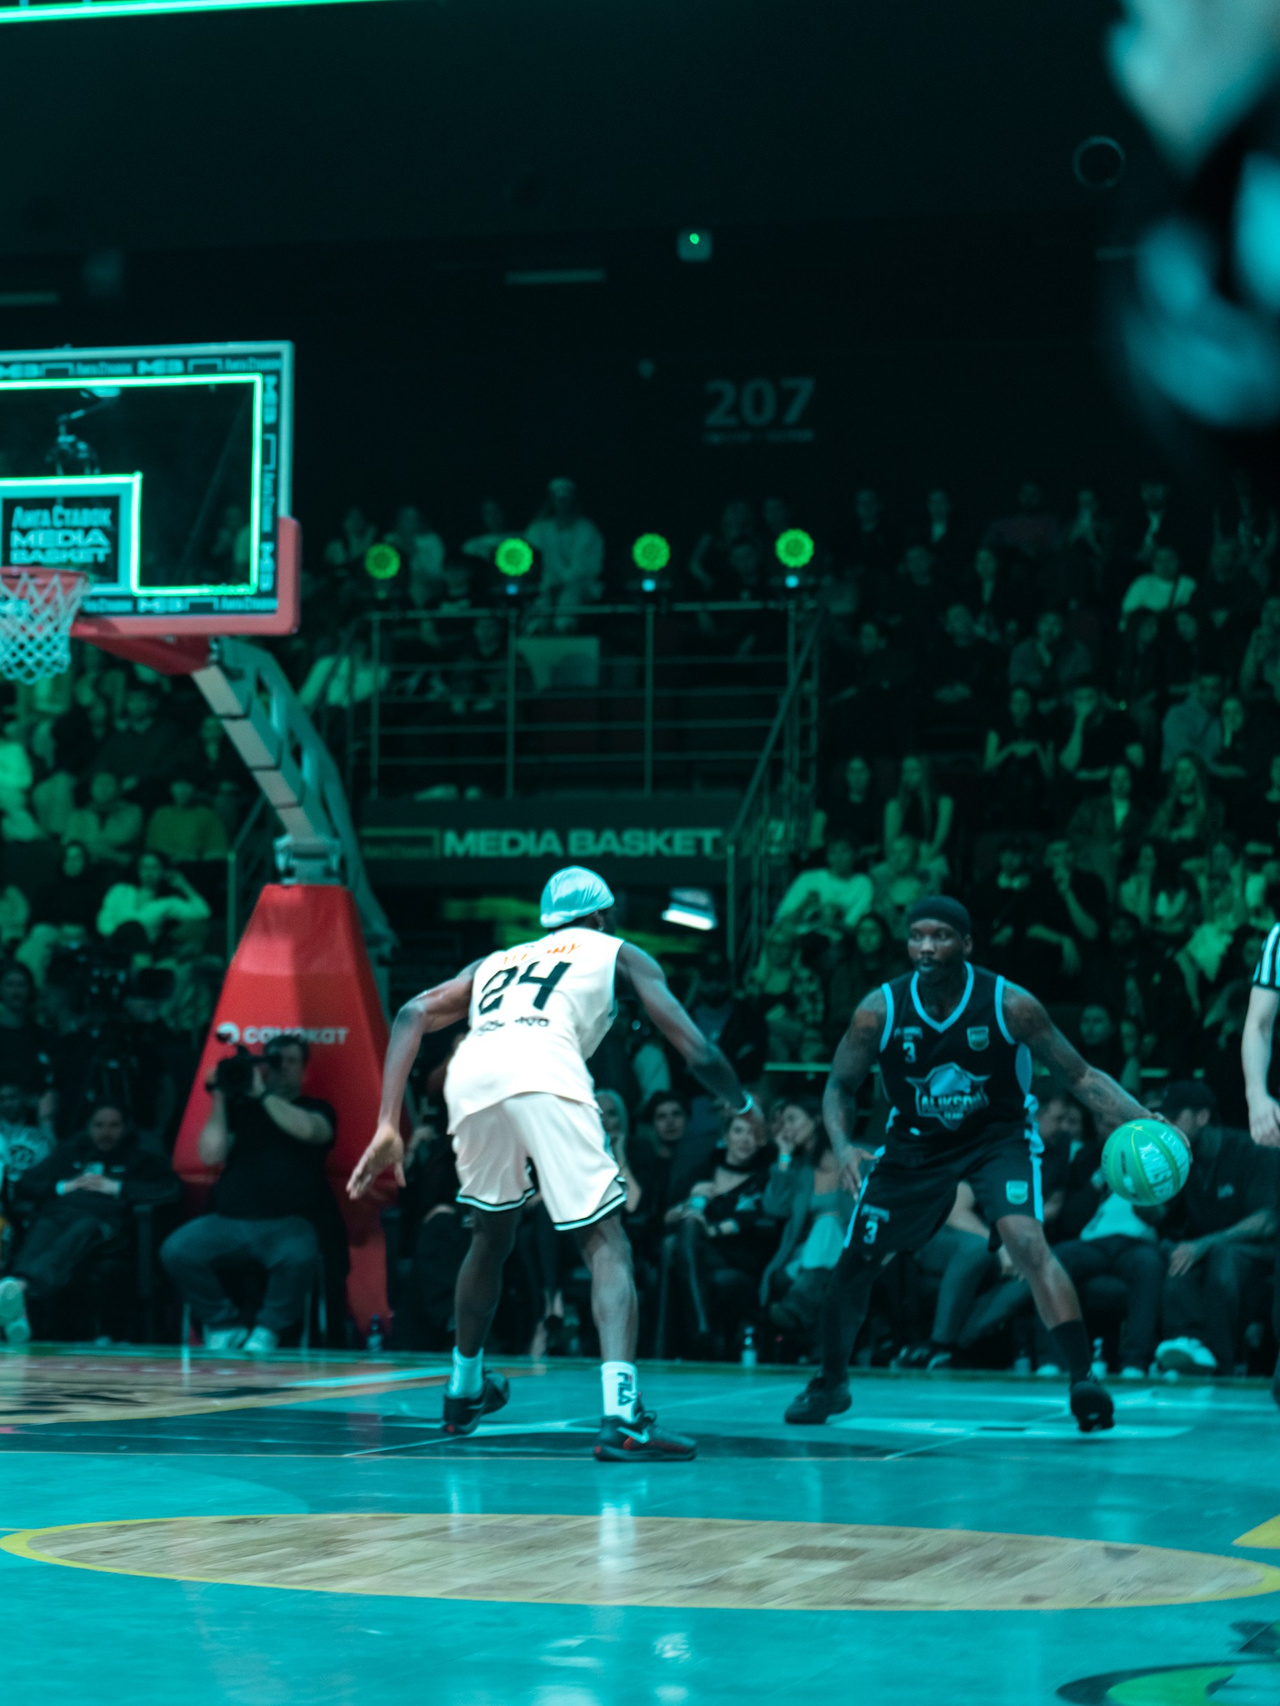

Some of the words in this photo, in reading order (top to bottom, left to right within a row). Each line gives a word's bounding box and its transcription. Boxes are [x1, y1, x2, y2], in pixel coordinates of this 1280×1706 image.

[705, 377, 815, 426] 207
[10, 529, 111, 549] MEDIA
[10, 548, 111, 564] BASKET
[443, 828, 565, 858] MEDIA
[567, 828, 721, 858] BASKET
[478, 960, 573, 1016] 24
[902, 1041, 917, 1063] 3
[863, 1220, 878, 1244] 3
